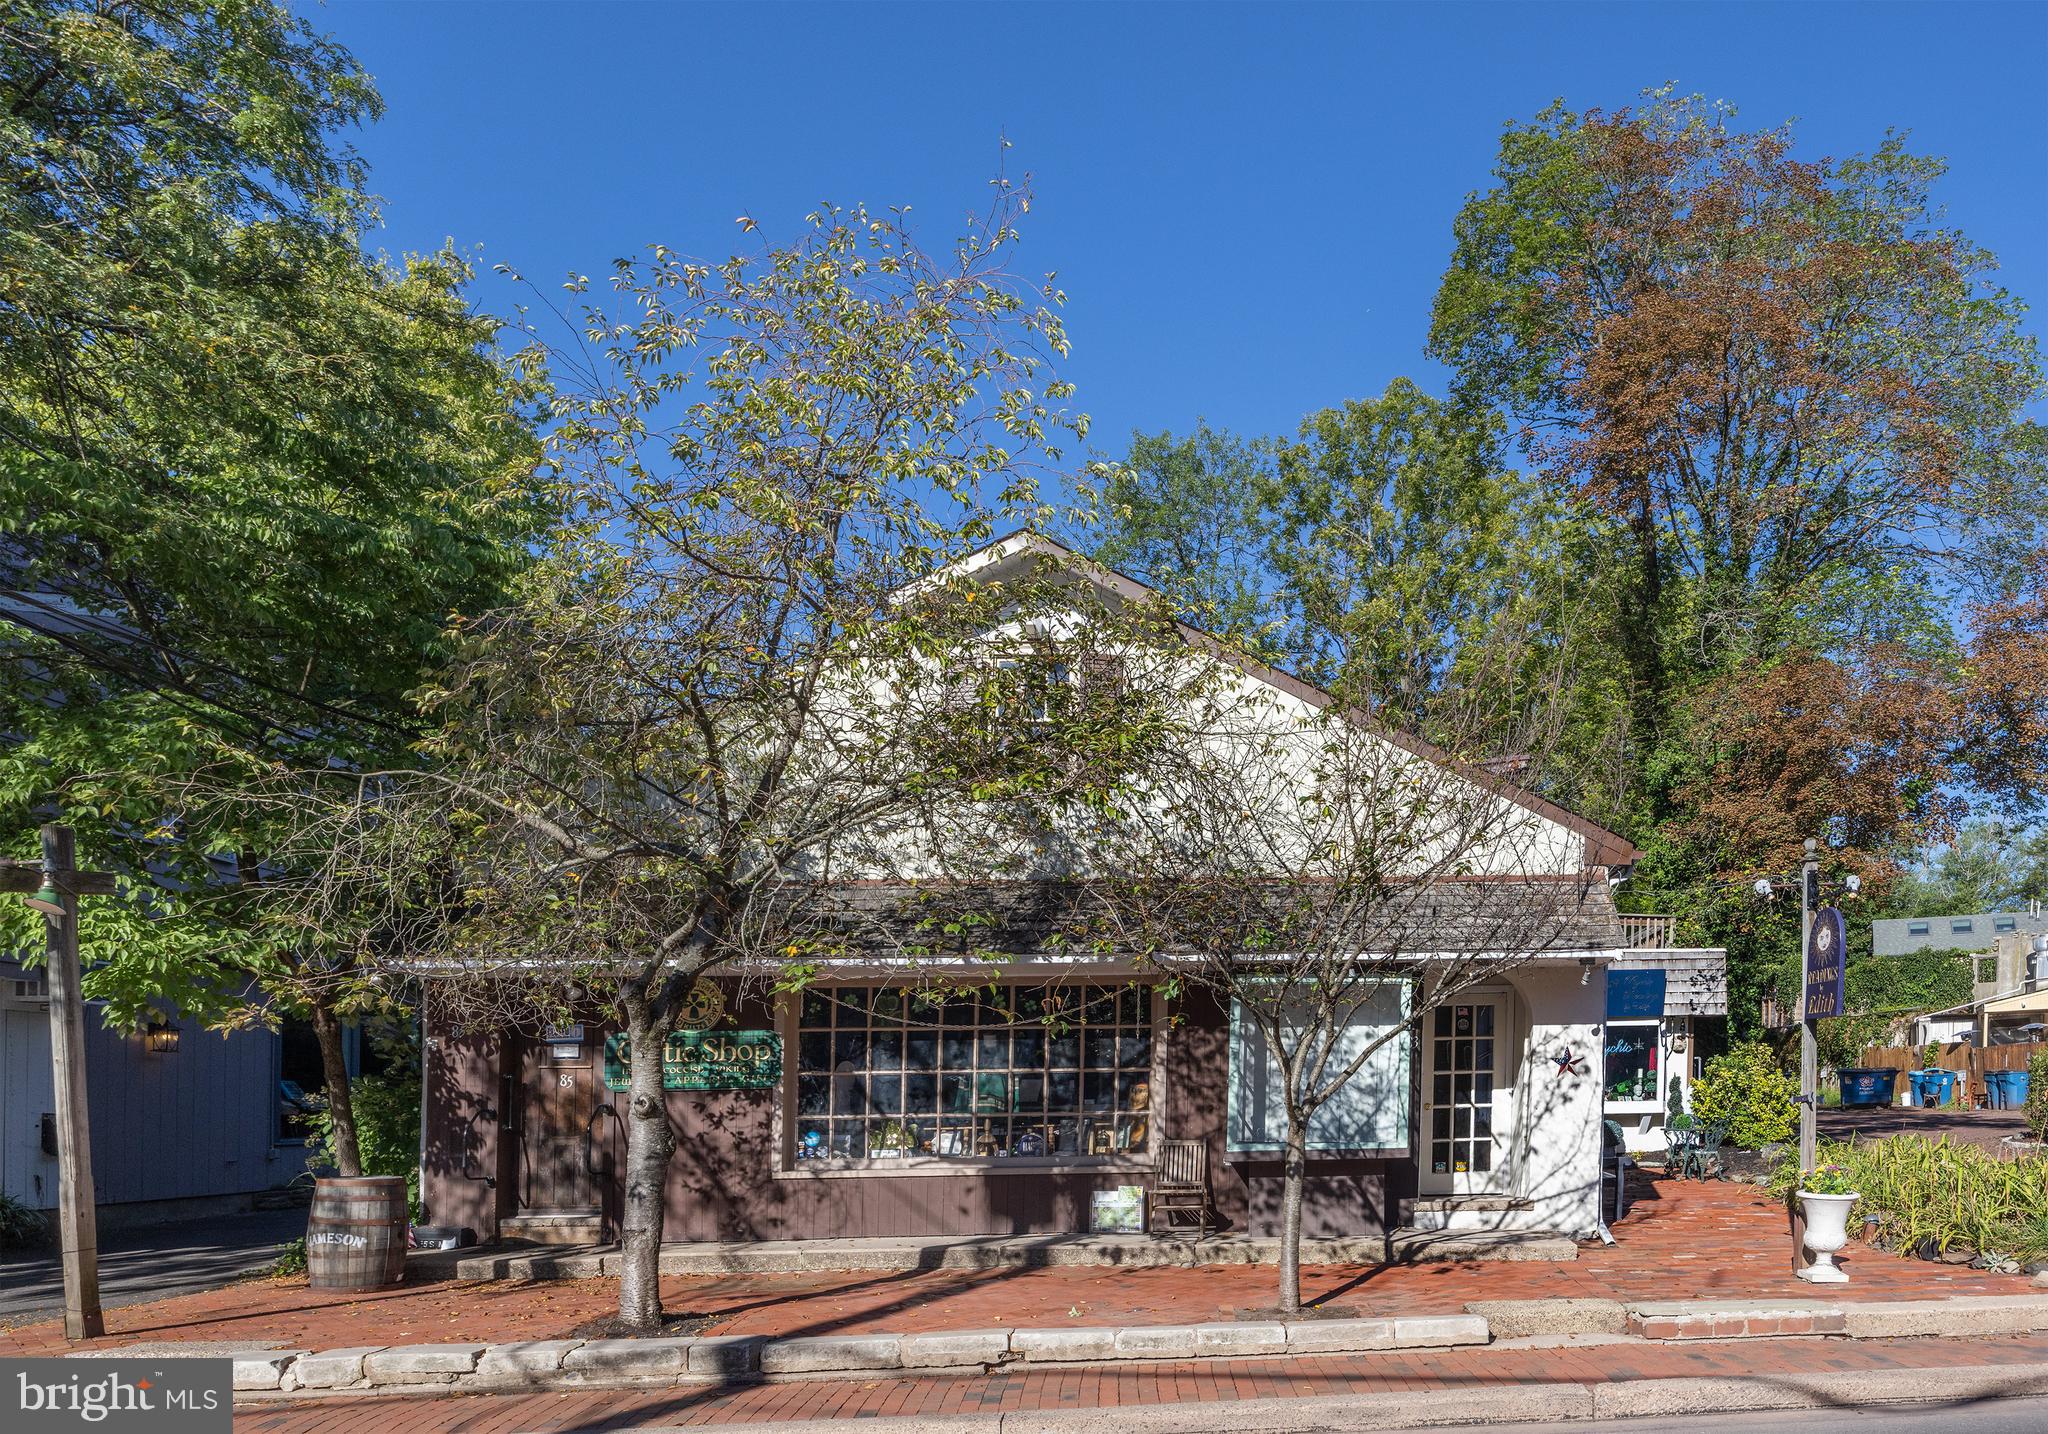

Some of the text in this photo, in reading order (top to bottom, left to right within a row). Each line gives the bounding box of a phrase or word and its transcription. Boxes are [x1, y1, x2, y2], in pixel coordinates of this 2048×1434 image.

[1808, 966, 1838, 985] READINGS
[1808, 993, 1835, 1015] Edith
[616, 1037, 772, 1068] Ctic Shop
[1605, 1038, 1633, 1057] ychic
[559, 1073, 574, 1089] 85
[308, 1232, 365, 1249] JAMESON
